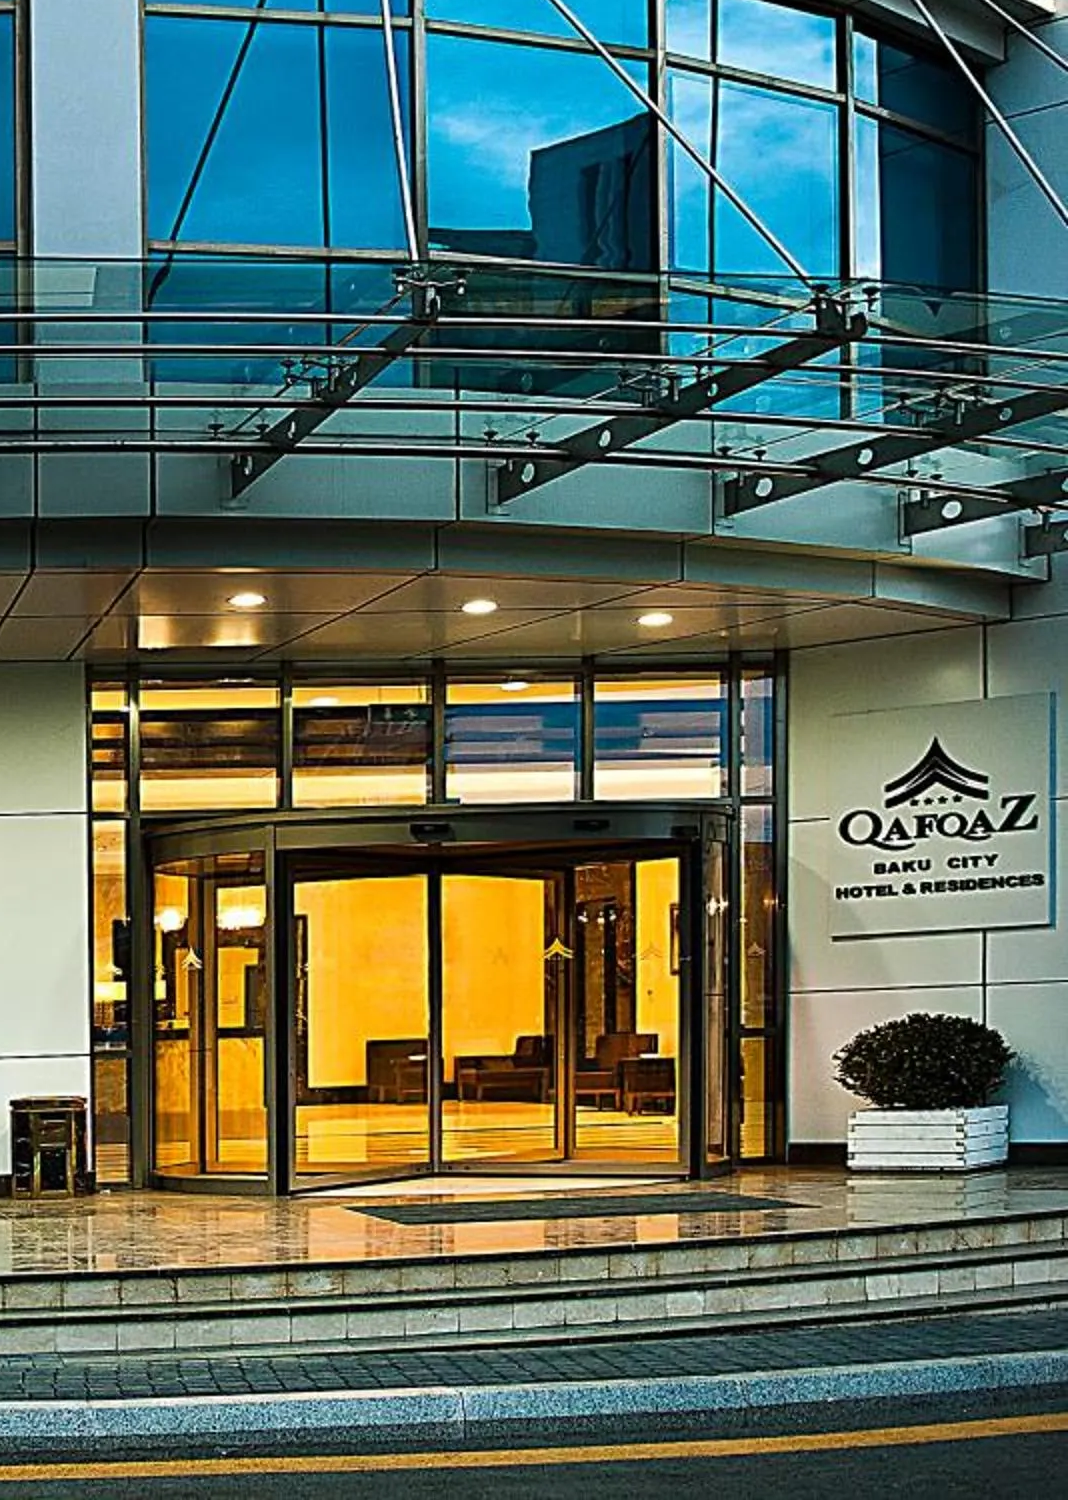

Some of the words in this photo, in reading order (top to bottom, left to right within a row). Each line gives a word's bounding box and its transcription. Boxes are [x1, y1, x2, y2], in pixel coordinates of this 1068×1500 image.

[838, 793, 1039, 851] QAFQAZ
[873, 859, 931, 875] BAKU
[947, 853, 999, 869] CITY
[835, 884, 899, 900] HOTEL
[901, 882, 917, 895] &
[919, 873, 1045, 895] RESIDENCES
